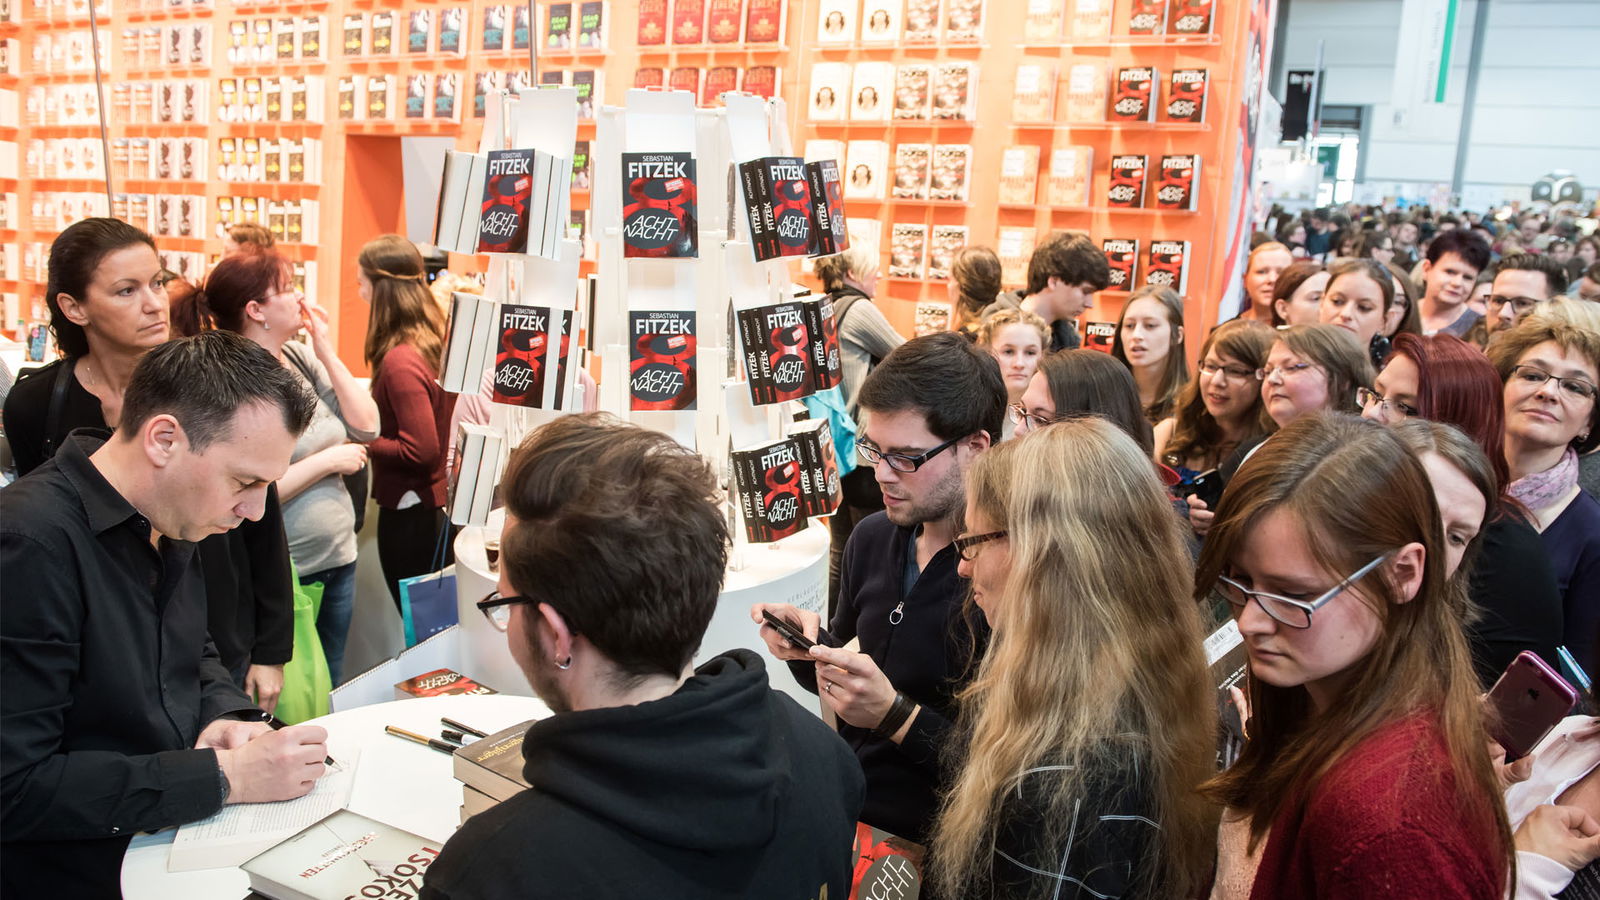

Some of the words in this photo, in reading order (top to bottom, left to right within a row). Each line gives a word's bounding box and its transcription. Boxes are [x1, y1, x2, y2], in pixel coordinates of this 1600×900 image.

[1120, 70, 1151, 82] FITZEK
[1172, 72, 1205, 83] FITZEK
[489, 158, 530, 175] FITZEK
[628, 162, 687, 178] FITZEK
[1113, 158, 1143, 169] FITZEK
[1163, 158, 1193, 169] FITZEK
[770, 165, 805, 181] FITZEK
[485, 212, 519, 226] ACHT
[631, 215, 679, 230] ACHT
[751, 204, 762, 234] FITZEK
[763, 201, 775, 231] FITZEK
[781, 215, 807, 228] ACHT
[817, 202, 829, 230] FITZEK
[480, 221, 518, 237] NACHT
[623, 225, 679, 241] NACHT
[777, 224, 809, 239] NACHT
[1103, 242, 1134, 252] FITZEK
[1151, 243, 1183, 254] FITZEK
[502, 313, 545, 332] FITZEK
[635, 319, 691, 335] FITZEK
[767, 310, 803, 330] FITZEK
[814, 340, 825, 366] FITZEK
[499, 363, 534, 379] ACHT
[748, 352, 759, 379] FITZEK
[760, 350, 771, 378] FITZEK
[777, 361, 804, 373] ACHT
[494, 372, 533, 392] NACHT
[639, 369, 683, 384] ACHT
[772, 370, 805, 384] NACHT
[630, 379, 683, 395] NACHT
[761, 447, 795, 470] FITZEK
[801, 469, 811, 494] FITZEK
[814, 467, 825, 492] FITZEK
[742, 491, 753, 518] FITZEK
[755, 490, 766, 517] FITZEK
[771, 497, 796, 512] ACHT
[767, 506, 798, 523] NACHT
[423, 676, 458, 690] ACHT
[344, 847, 440, 900] TSOKO
[886, 860, 914, 900] CHT
